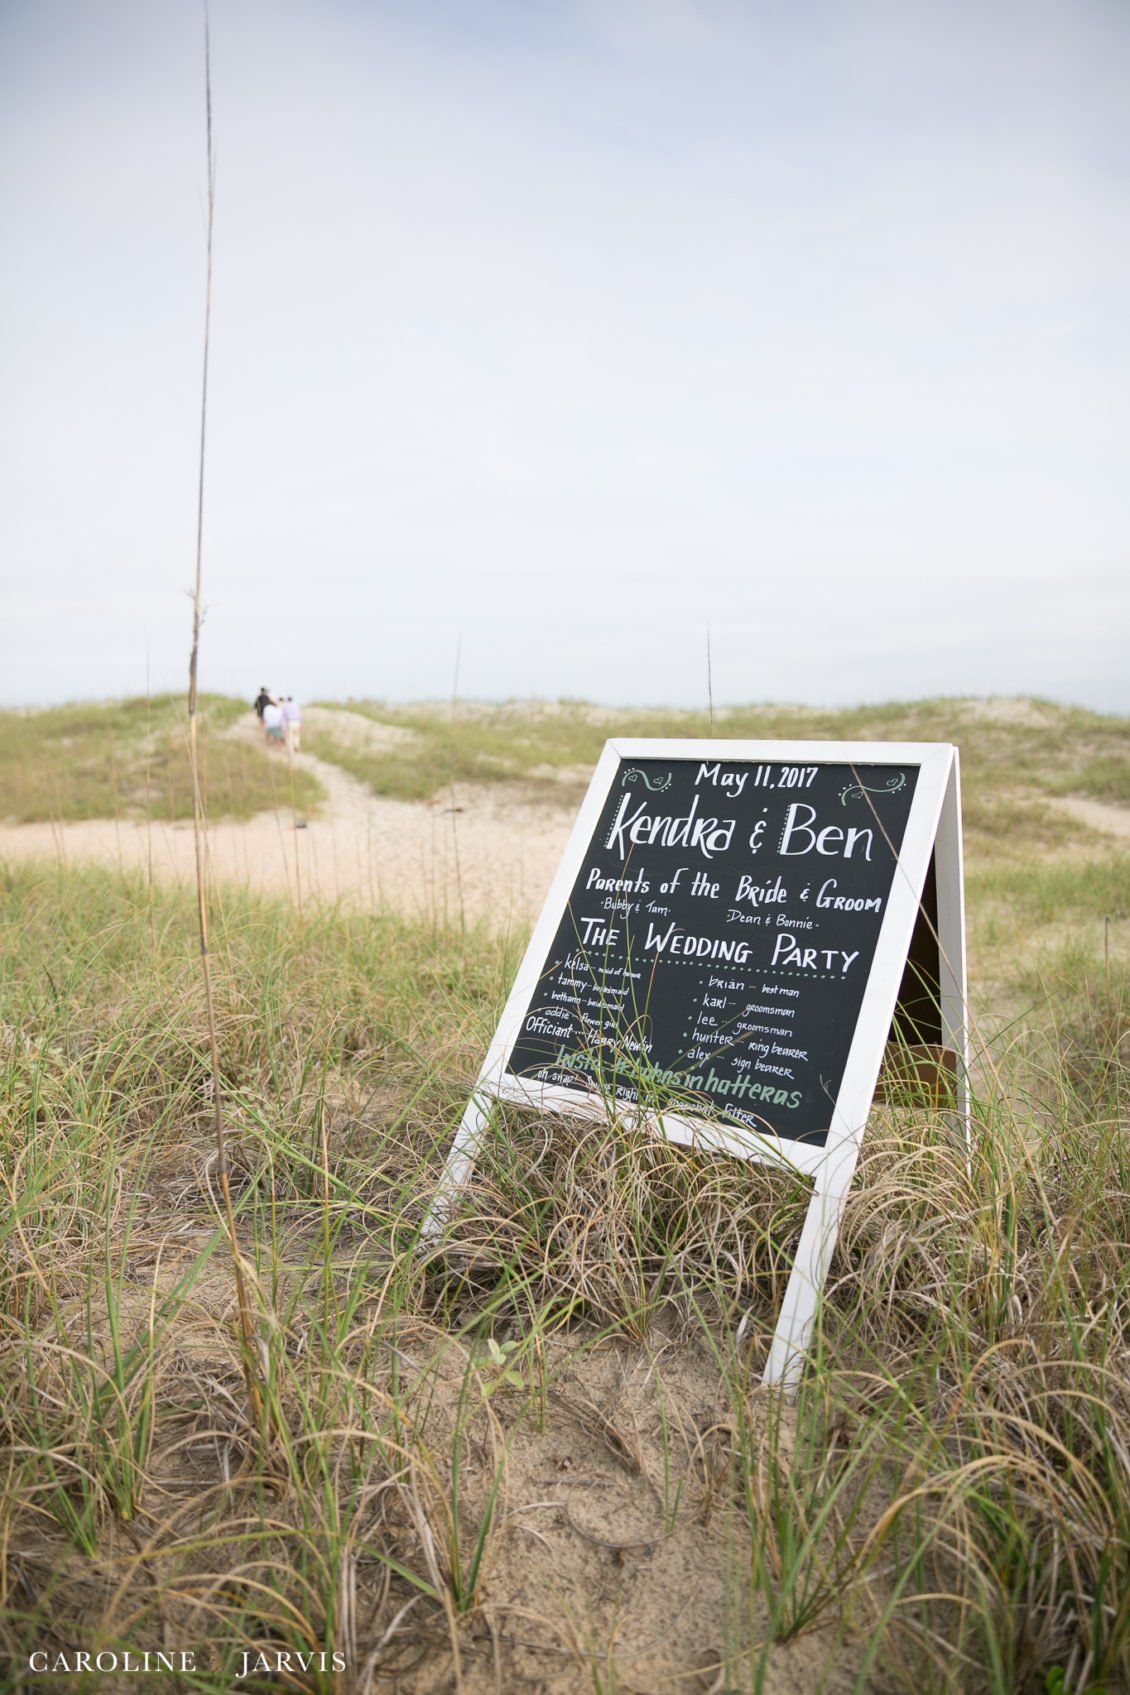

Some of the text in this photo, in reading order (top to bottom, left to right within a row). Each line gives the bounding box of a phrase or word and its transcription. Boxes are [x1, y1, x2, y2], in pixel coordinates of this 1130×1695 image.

[695, 764, 749, 797] May
[750, 808, 767, 854] &
[780, 803, 873, 861] Ben
[660, 868, 689, 893] of
[691, 872, 719, 898] the
[735, 875, 787, 906] Bride
[604, 897, 633, 919] Bubby
[646, 900, 668, 917] Tam
[726, 909, 761, 925] Dean
[776, 914, 813, 929] Bonnie
[581, 917, 859, 972] THE WEDDING PARTY
[779, 987, 800, 998] man
[697, 1011, 718, 1026] lee
[687, 1047, 711, 1067] alex
[731, 1057, 751, 1073] sign
